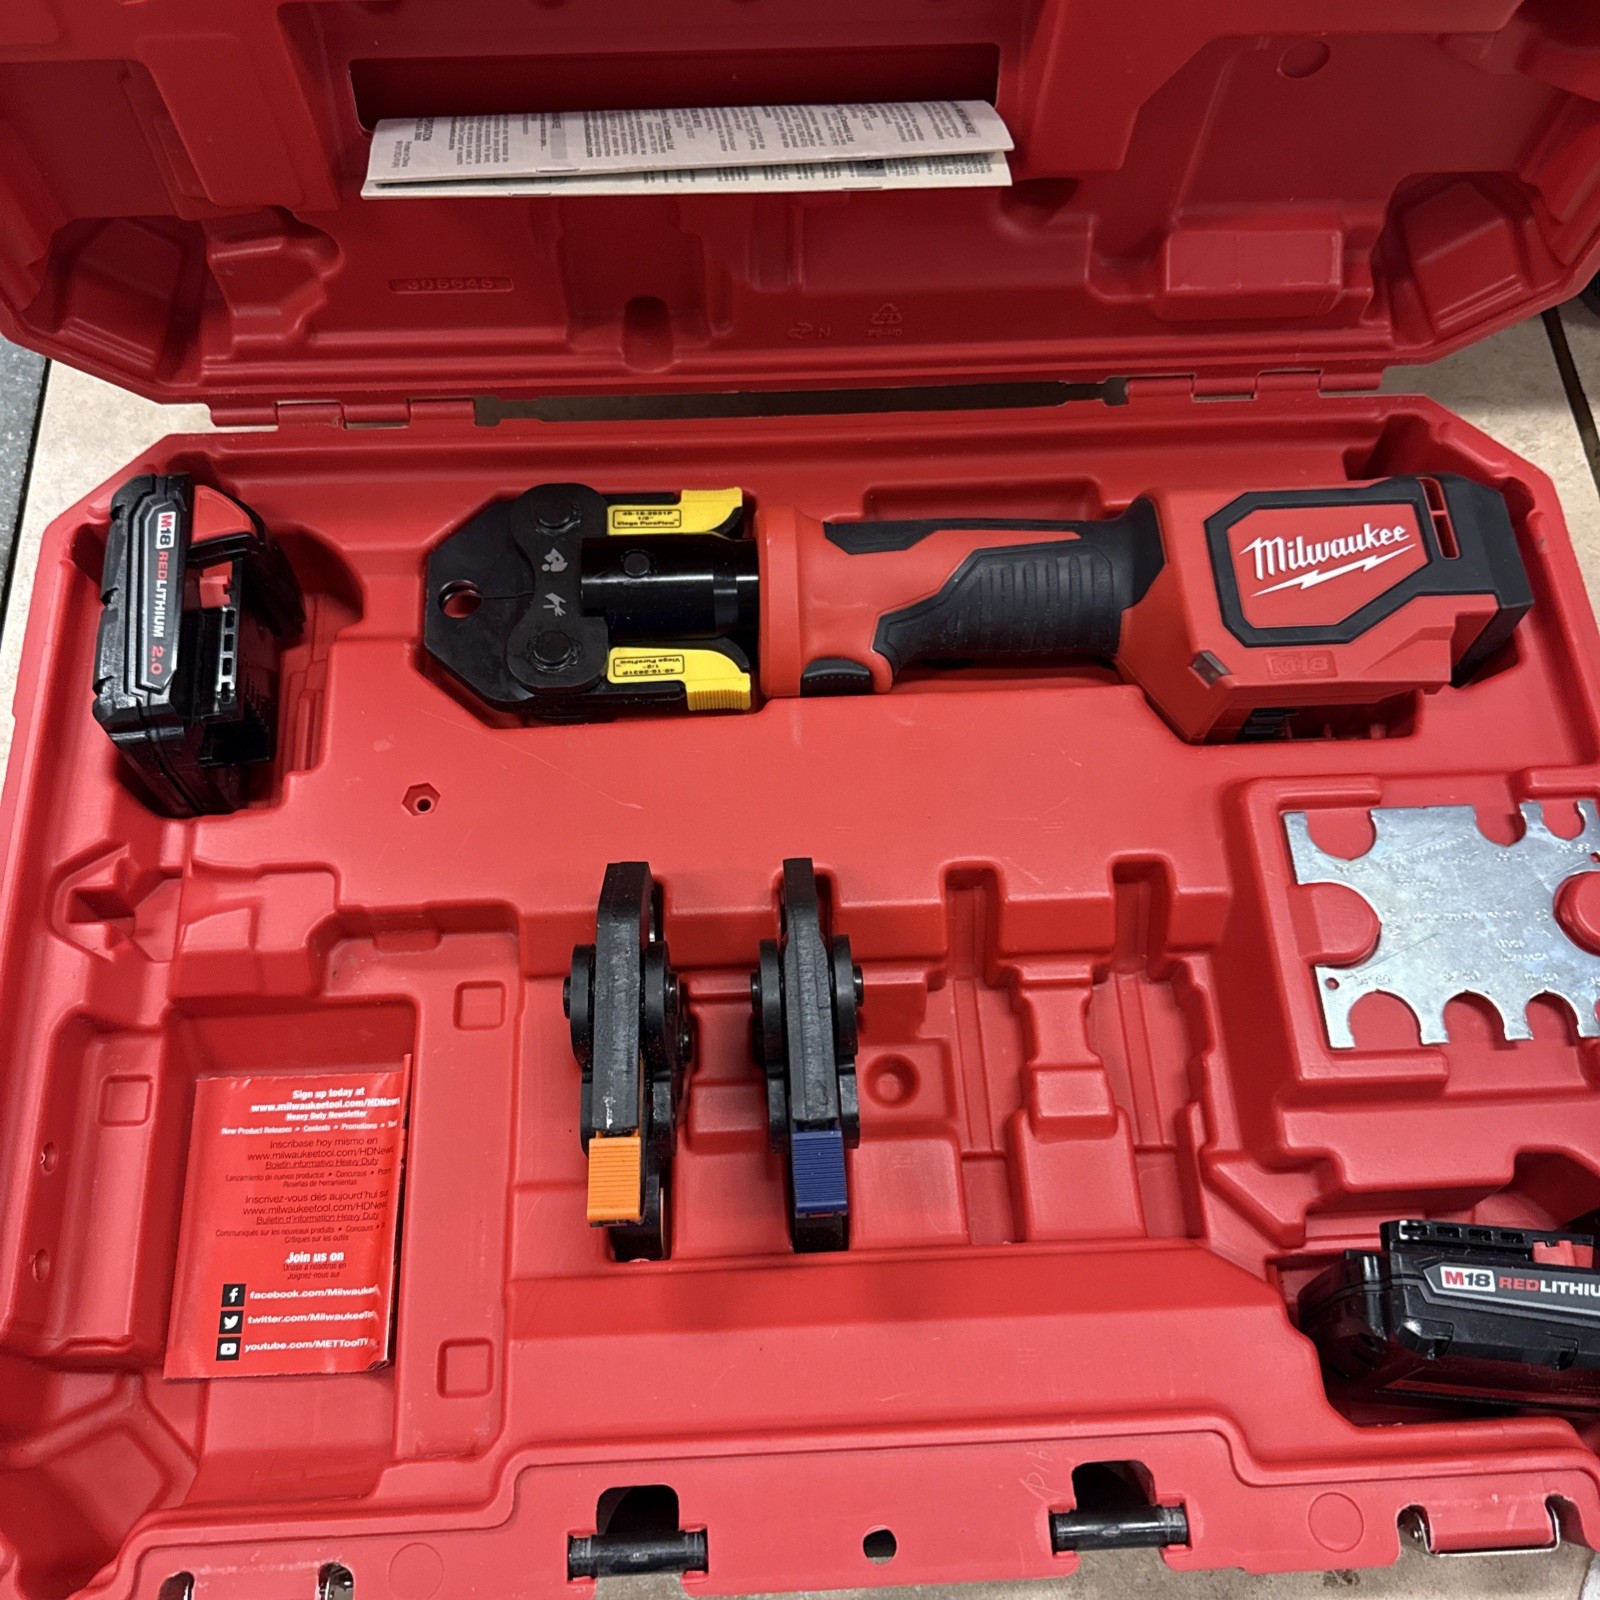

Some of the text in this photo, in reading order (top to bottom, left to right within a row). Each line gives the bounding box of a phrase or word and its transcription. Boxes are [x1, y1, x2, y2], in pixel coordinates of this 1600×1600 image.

[158, 514, 173, 546] M18
[1238, 522, 1411, 581] Milwaukee
[153, 550, 170, 638] REDLITHIUM
[150, 644, 164, 676] 2.0
[1270, 656, 1330, 676] M18
[292, 1086, 365, 1100] Sign up today at
[286, 1110, 368, 1122] Heavy Duty Newsletter
[221, 1127, 237, 1135] New
[237, 1127, 263, 1135] Product
[264, 1126, 293, 1134] Releases
[303, 1124, 331, 1132] Contests
[341, 1122, 378, 1130] Promotions
[316, 1139, 332, 1148] hoy
[334, 1138, 364, 1146] mismo
[293, 1160, 334, 1168] informativo
[336, 1159, 360, 1168] Heavy
[362, 1157, 379, 1166] Duty
[226, 1174, 264, 1182] Lanzamiento
[295, 1172, 325, 1180] productos
[335, 1170, 367, 1178] Concursos
[319, 1179, 358, 1187] herramientas
[245, 1193, 308, 1204] Inscrivez-vous
[380, 1190, 389, 1198] sur
[256, 1212, 379, 1224] Bulletin d'information Heavy Duty
[310, 1226, 335, 1235] produits
[346, 1224, 374, 1233] Concours
[284, 1235, 311, 1244] Critiques
[286, 1252, 344, 1264] Join us on
[310, 1262, 337, 1270] nosotros
[287, 1272, 329, 1281] Joignez-nous
[1444, 1270, 1491, 1287] M18
